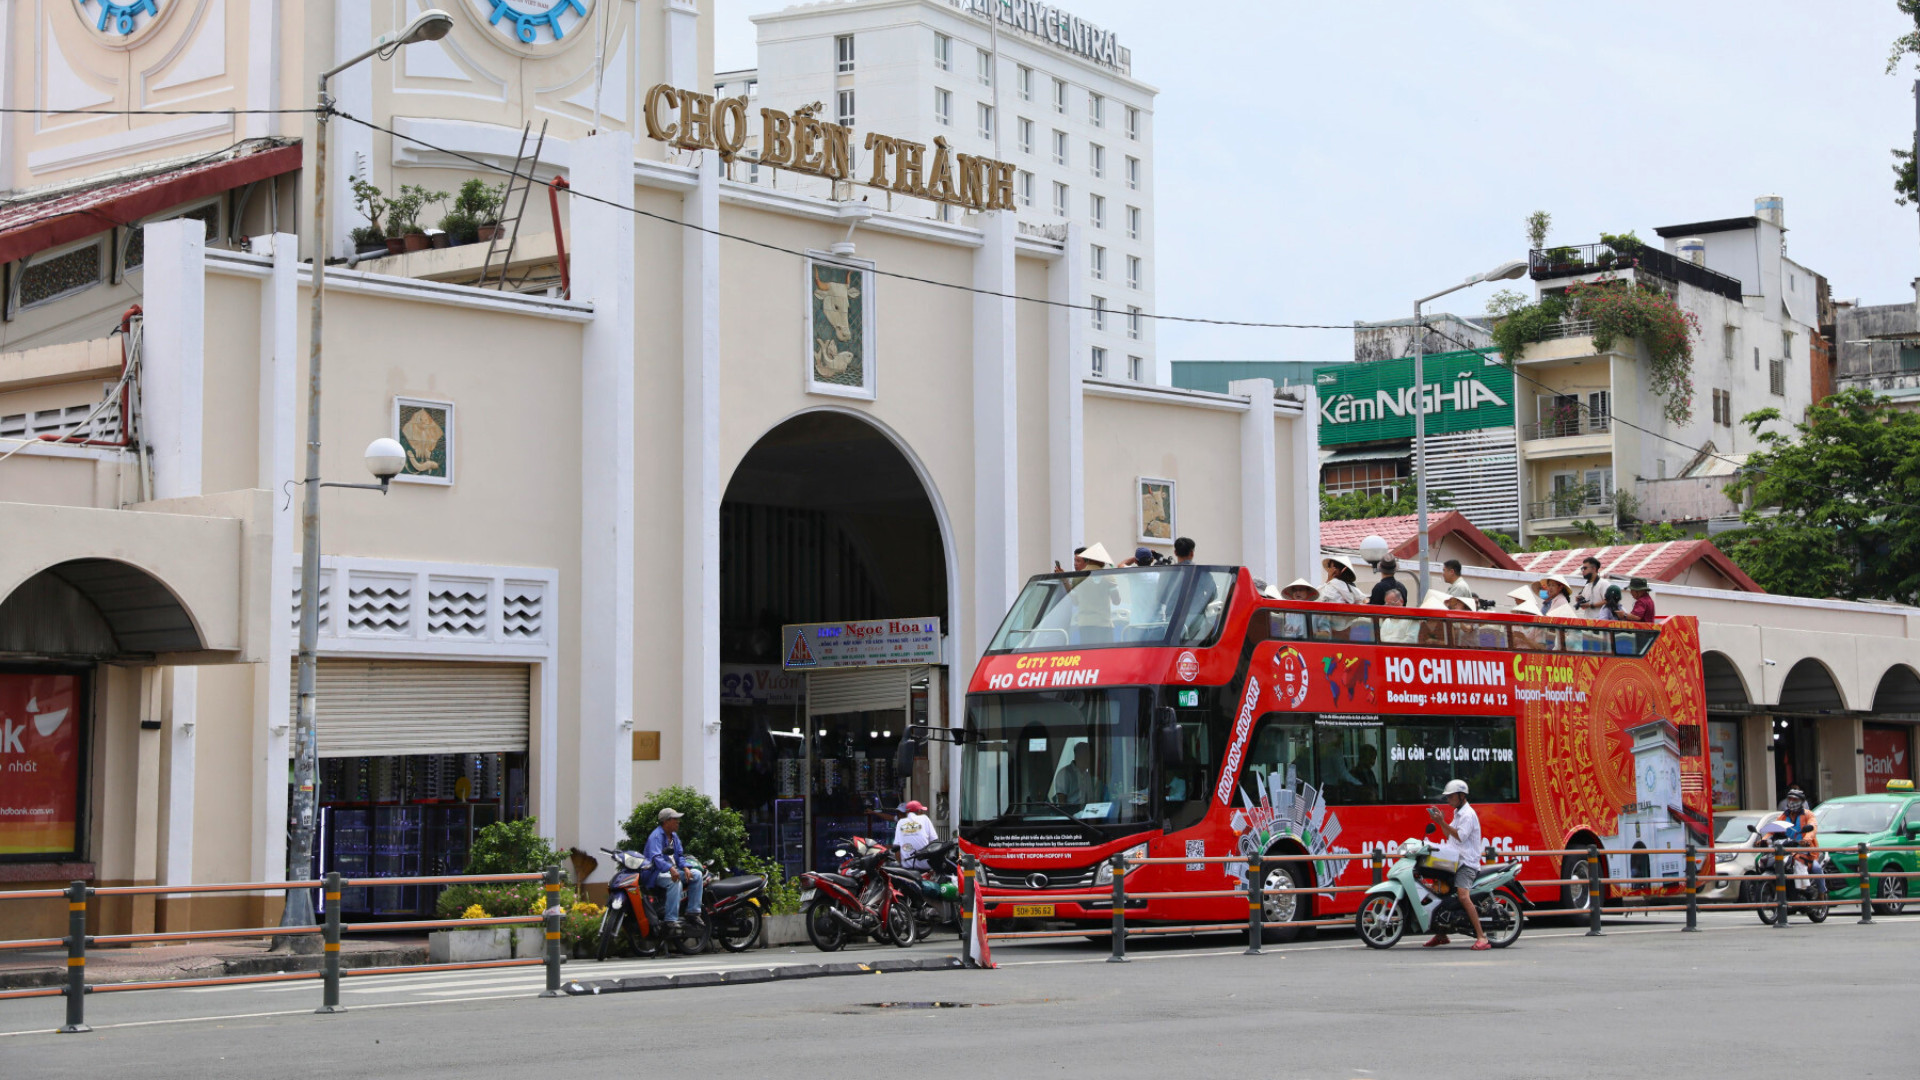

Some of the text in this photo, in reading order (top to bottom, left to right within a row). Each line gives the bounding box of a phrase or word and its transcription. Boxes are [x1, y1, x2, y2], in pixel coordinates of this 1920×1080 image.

[517, 14, 537, 43] 6
[1044, 5, 1124, 68] CENTRAL
[645, 84, 1017, 212] CHỢ BẾN THÀNH
[817, 627, 842, 637] SHOP
[846, 624, 883, 638] Ngọc
[888, 621, 920, 634] Hoa
[1016, 655, 1081, 669] CITY TOUR
[1385, 656, 1506, 686] HO CHI MINH
[1513, 653, 1574, 683] CITY TOUR
[988, 669, 1100, 689] HO CHI MINH
[1387, 690, 1508, 707] Booking: +84 913 67 44 12
[1514, 684, 1586, 706] hopon-hopoff.vn
[1390, 740, 1406, 761] SÀI
[1408, 744, 1425, 761] GÒN
[1435, 746, 1451, 764] CHỢ
[1453, 744, 1470, 761] LỚN
[1472, 748, 1490, 761] CITY
[1492, 748, 1514, 762] TOUR
[8, 760, 38, 772] nhất
[1864, 755, 1894, 774] Bank
